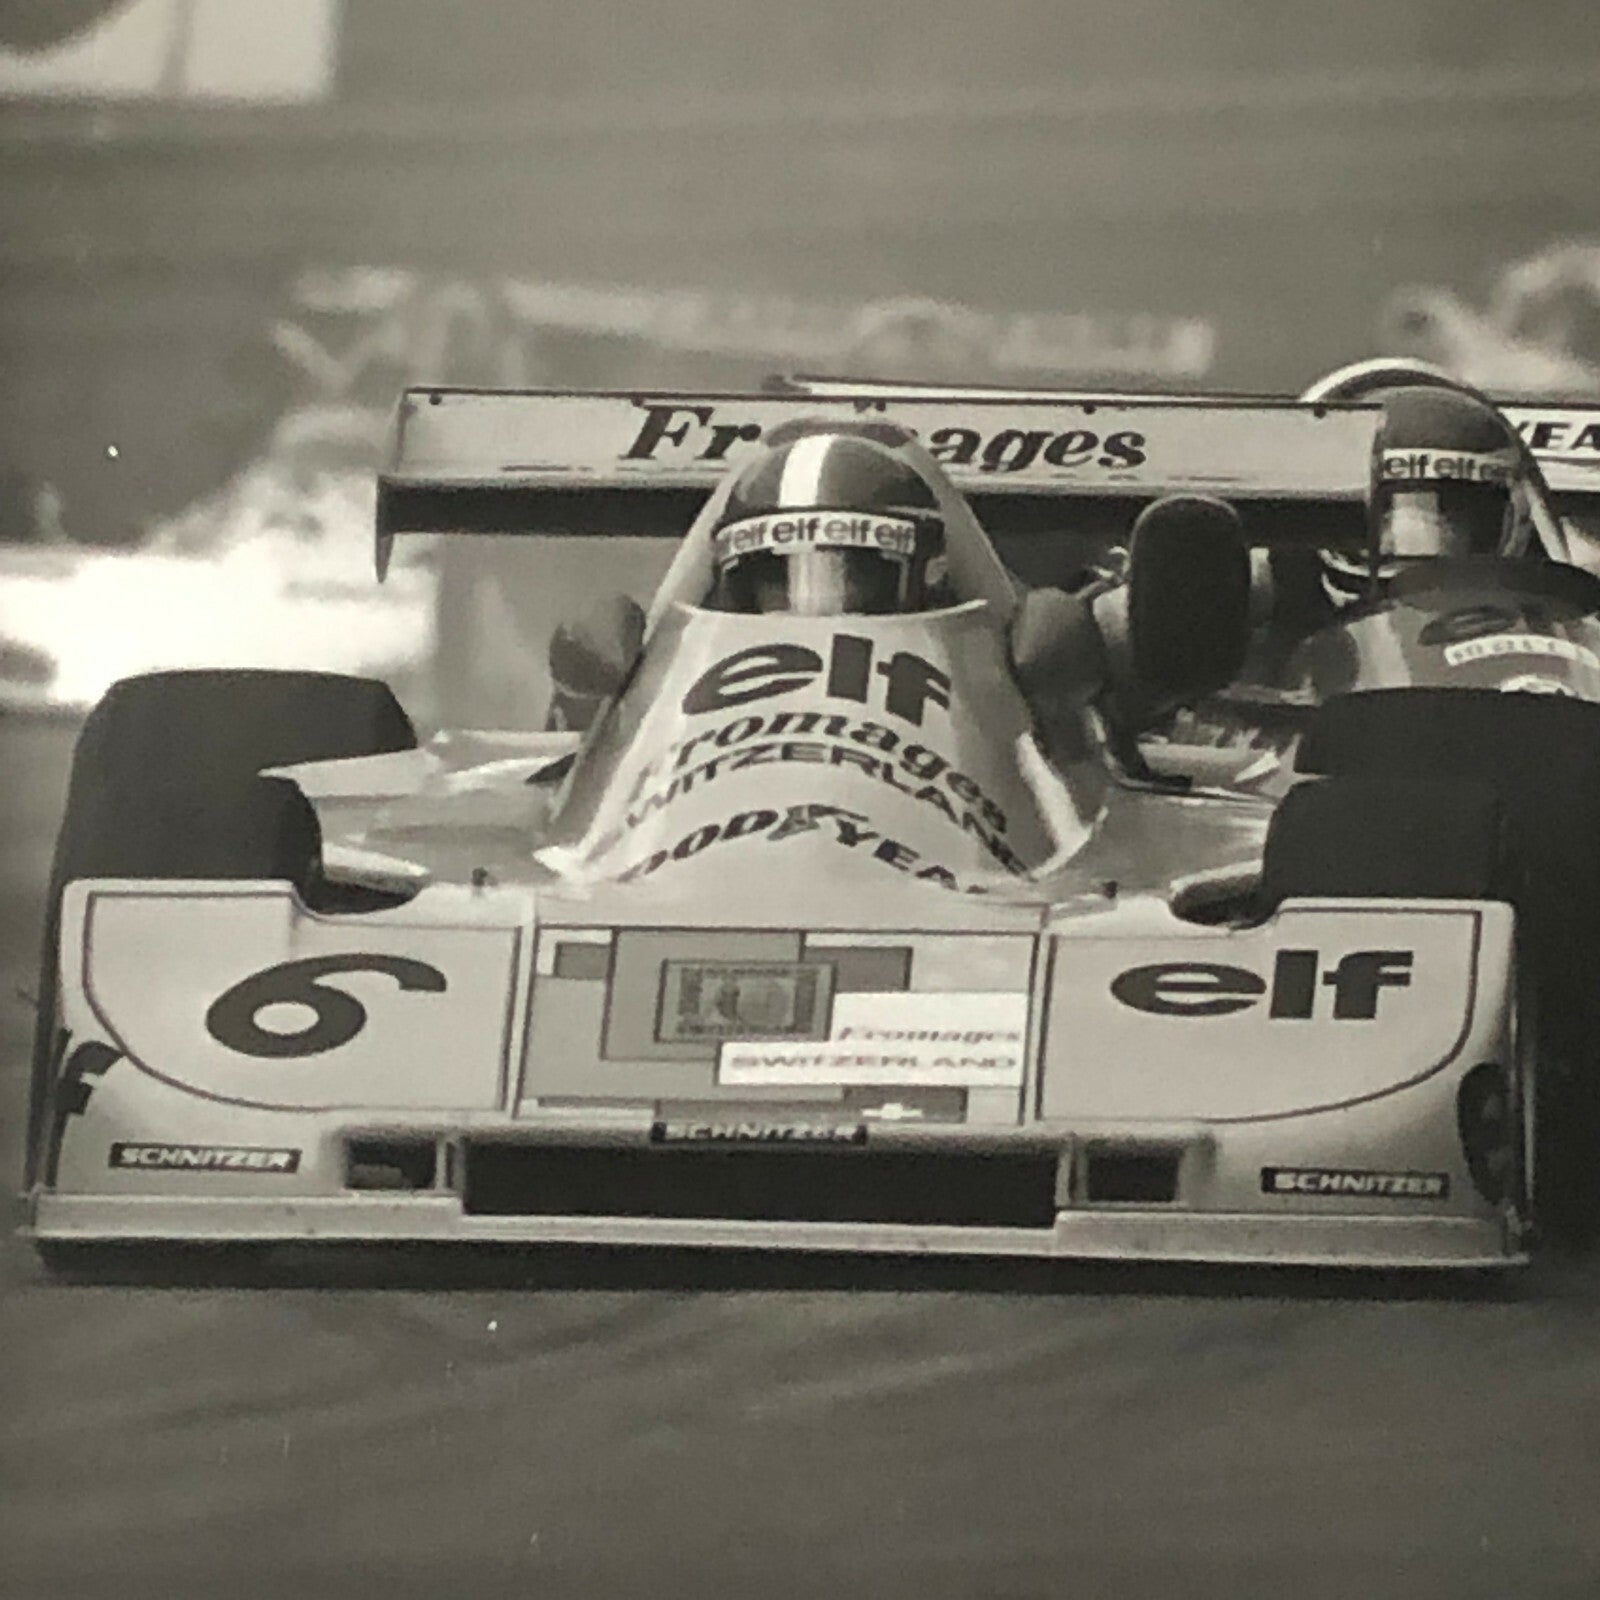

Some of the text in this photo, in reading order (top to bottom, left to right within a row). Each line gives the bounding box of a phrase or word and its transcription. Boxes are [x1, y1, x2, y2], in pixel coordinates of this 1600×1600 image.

[617, 403, 1148, 473] Frages
[1384, 453, 1430, 478] elf
[772, 517, 819, 544] elf
[824, 518, 872, 544] elf
[681, 633, 951, 727] elf
[588, 742, 1038, 882] WITZERLAND
[206, 952, 447, 1059] 6
[1109, 948, 1414, 1020] elf
[731, 1054, 1017, 1068] SWITZERLAND
[120, 1147, 292, 1168] SCHNITZER
[1274, 1172, 1443, 1194] SCHNITZER
